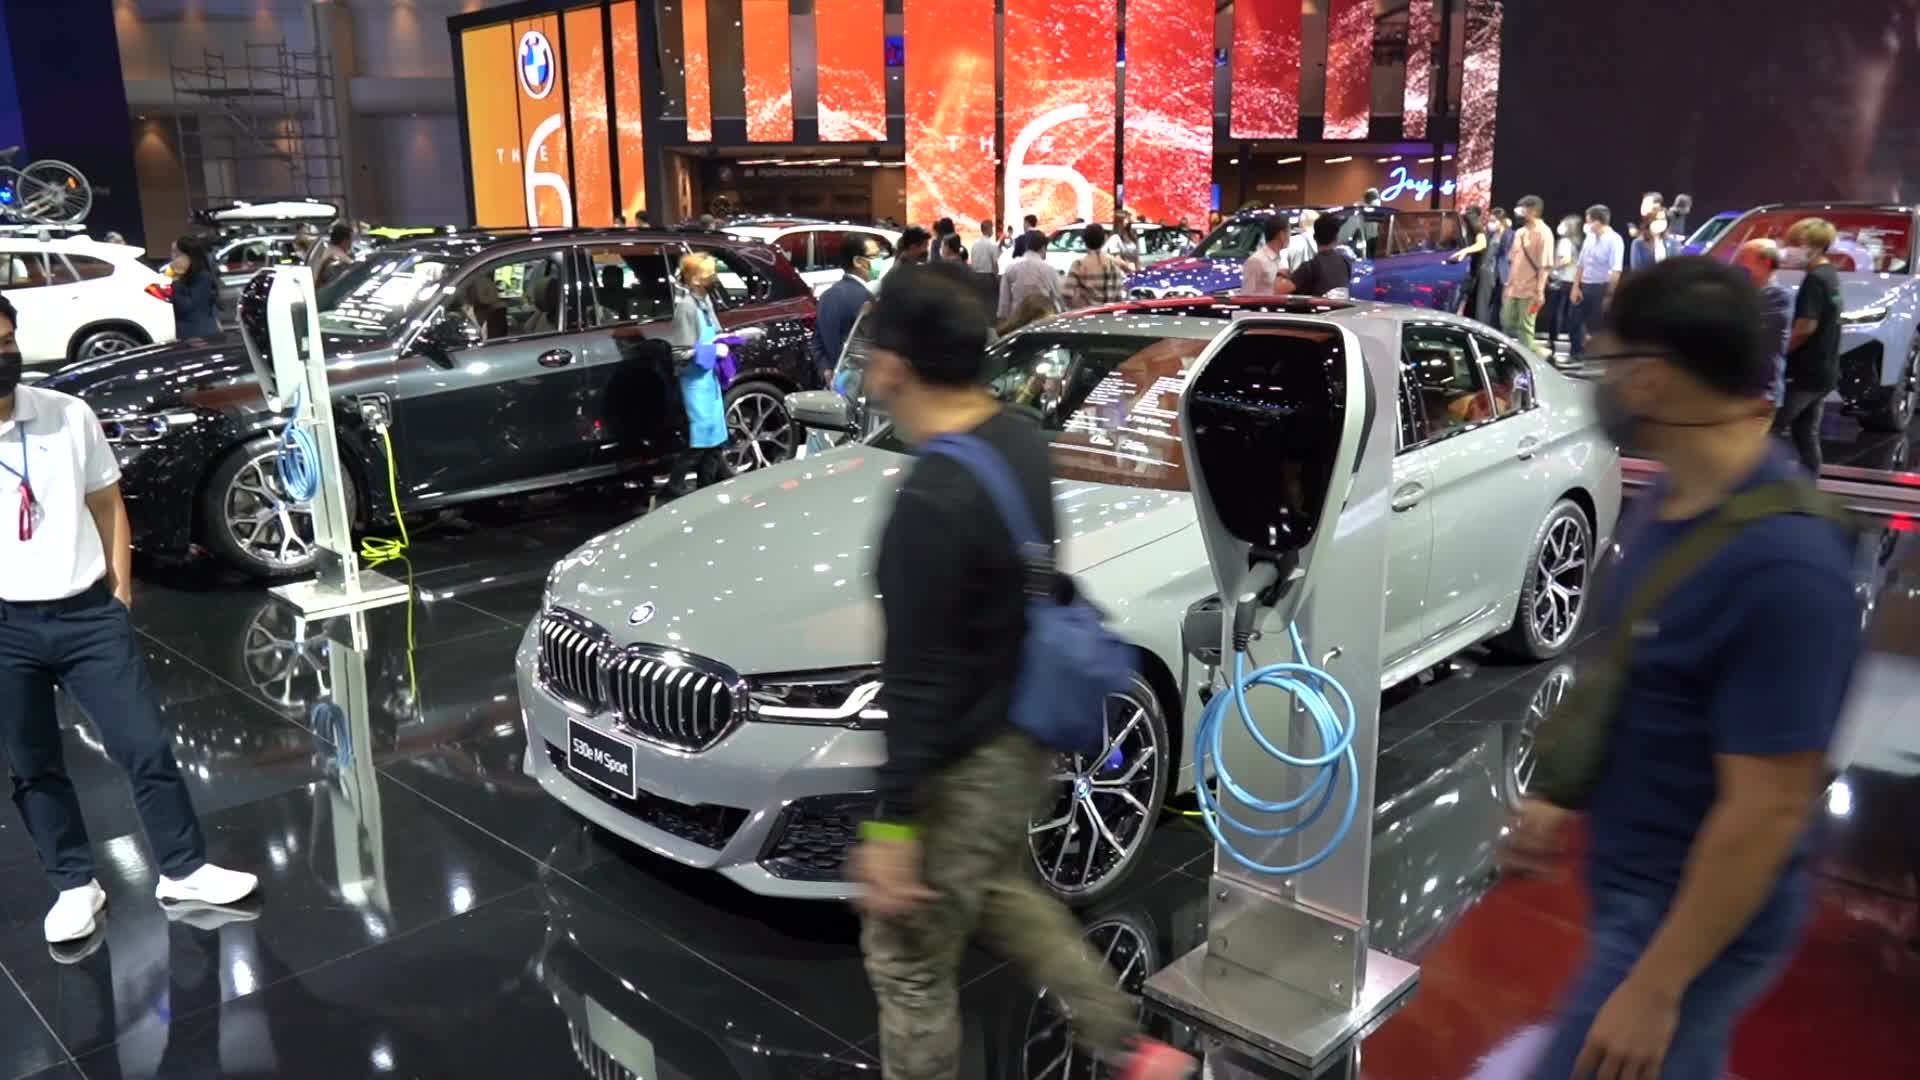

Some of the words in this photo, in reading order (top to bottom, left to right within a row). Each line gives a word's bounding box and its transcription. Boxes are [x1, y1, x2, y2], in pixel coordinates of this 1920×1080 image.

[573, 737, 593, 760] 530e
[594, 748, 603, 764] M
[603, 752, 628, 776] Sport
